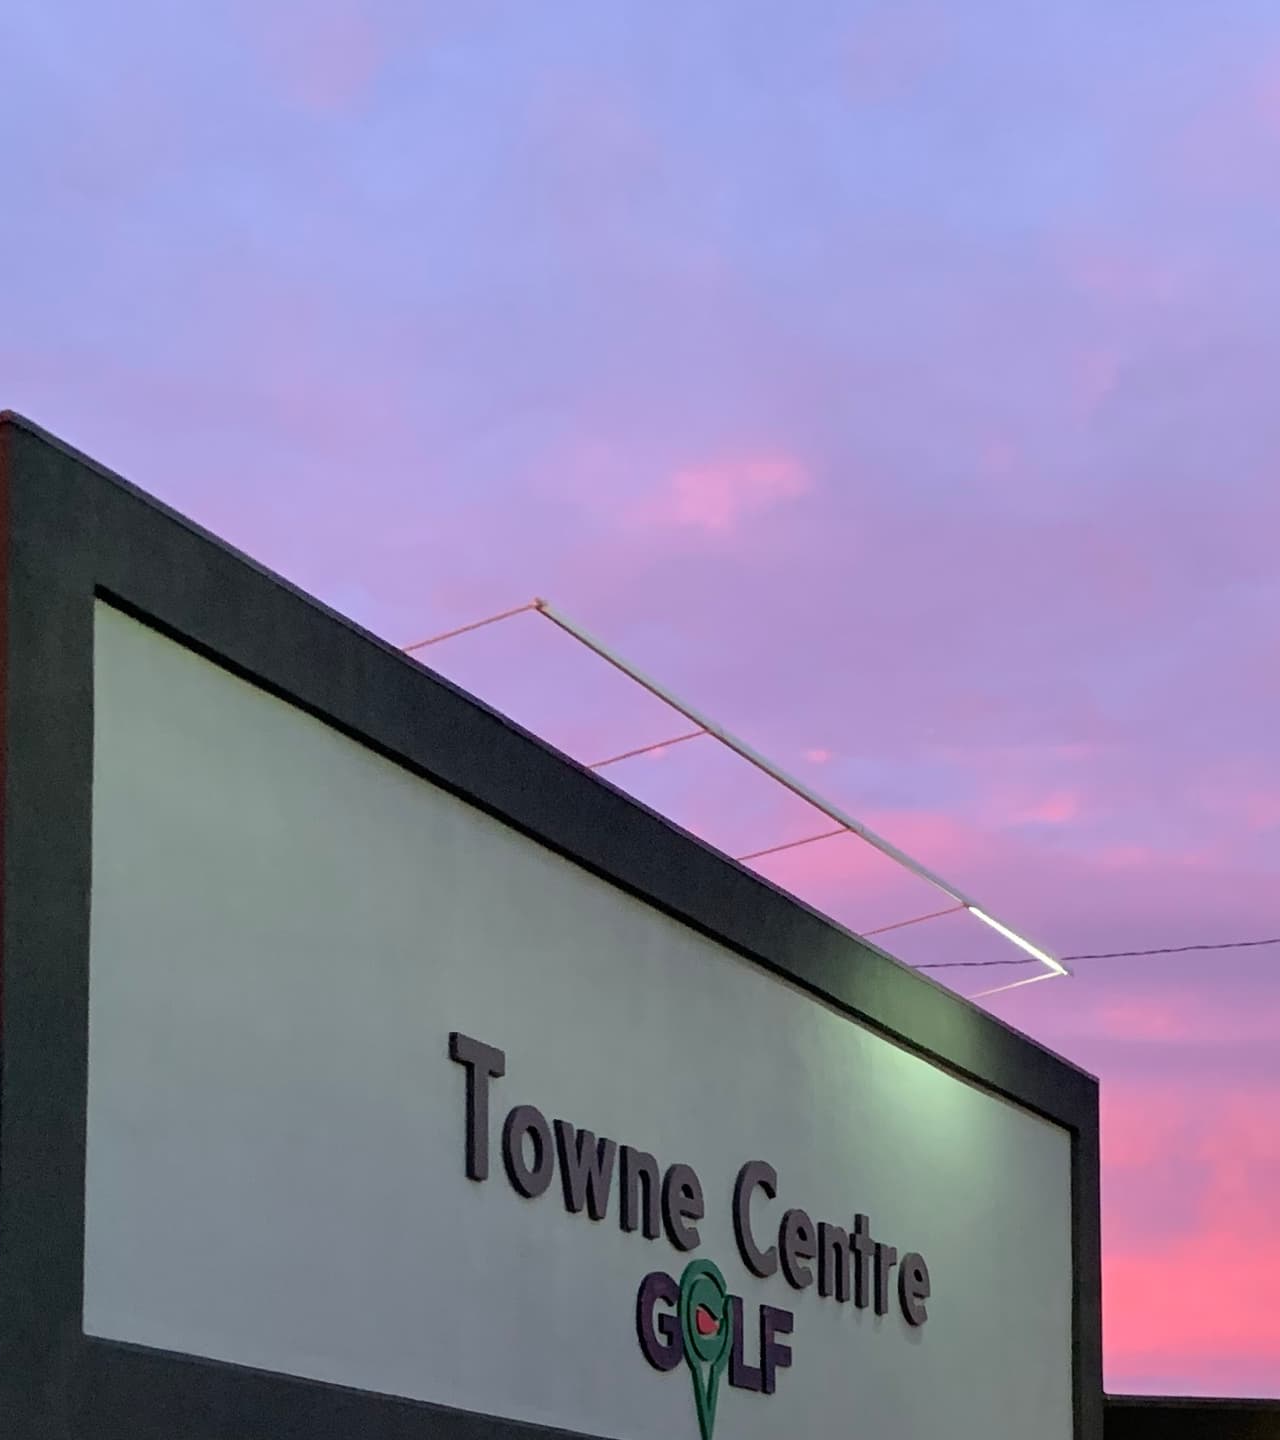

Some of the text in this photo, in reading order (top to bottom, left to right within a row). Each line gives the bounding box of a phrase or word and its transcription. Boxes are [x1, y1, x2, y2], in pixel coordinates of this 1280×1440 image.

[448, 1032, 931, 1326] Towne Centre
[636, 1258, 794, 1396] GOLF
